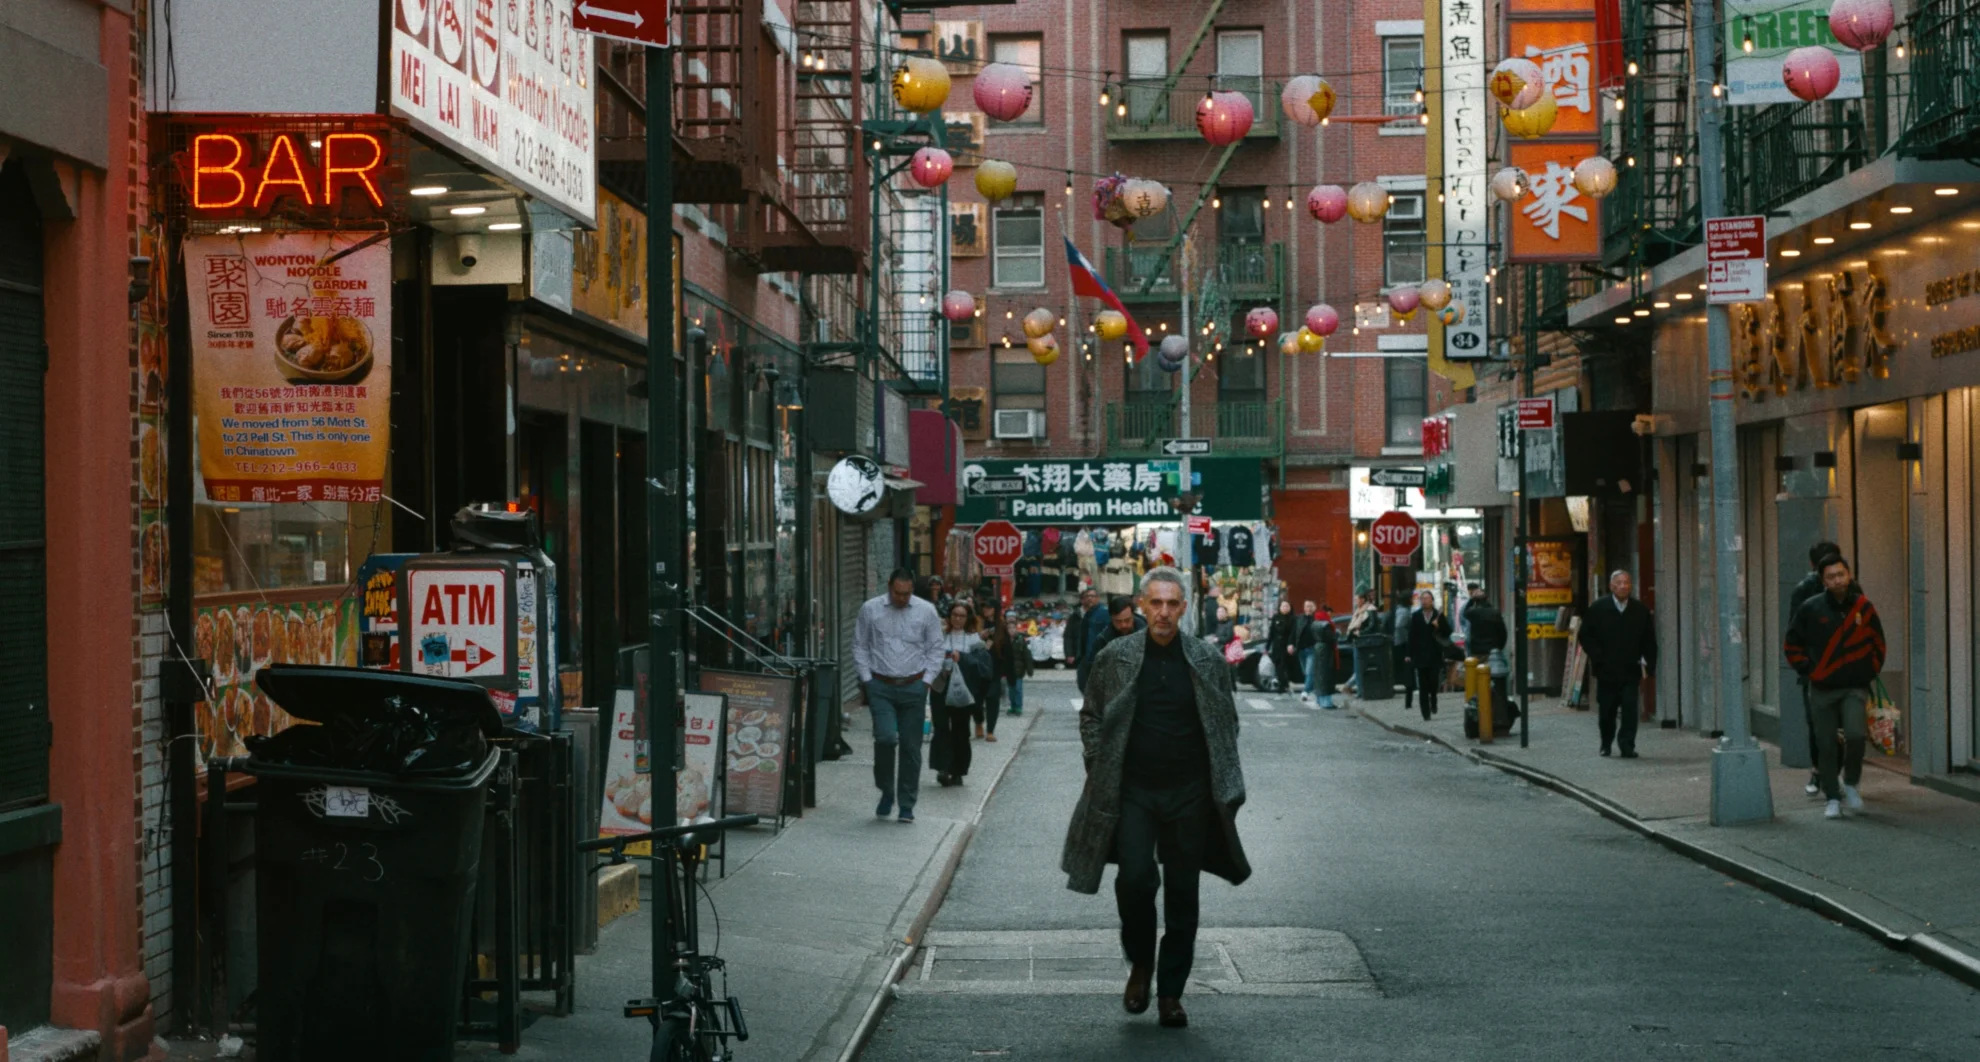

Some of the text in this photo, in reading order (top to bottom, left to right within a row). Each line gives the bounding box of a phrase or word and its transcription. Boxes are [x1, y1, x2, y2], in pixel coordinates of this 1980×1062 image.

[401, 50, 498, 151] MEI LAI WAH
[507, 51, 588, 152] Wonton Noodle
[193, 133, 383, 209] BAR
[514, 128, 583, 202] 212-966-4033
[1709, 220, 1755, 231] NO STANDING
[255, 255, 315, 266] WONTON
[286, 267, 341, 277] NOODLE
[313, 280, 367, 290] GARDEN
[207, 330, 233, 339] Since
[1455, 334, 1473, 348] 34
[222, 417, 368, 428] We moved from 56 Mott St.
[223, 431, 371, 443] to 23 Pell St. This is only one
[224, 446, 297, 456] in Chinatown.
[1013, 462, 1163, 493] 杰翔大藥房
[1002, 482, 1018, 490] WAY
[251, 486, 313, 502] 僅此一家
[1012, 499, 1101, 519] Paradigm
[1106, 498, 1168, 516] Health
[1375, 525, 1417, 545] STOP
[977, 536, 1019, 555] STOP
[421, 584, 495, 625] ATM
